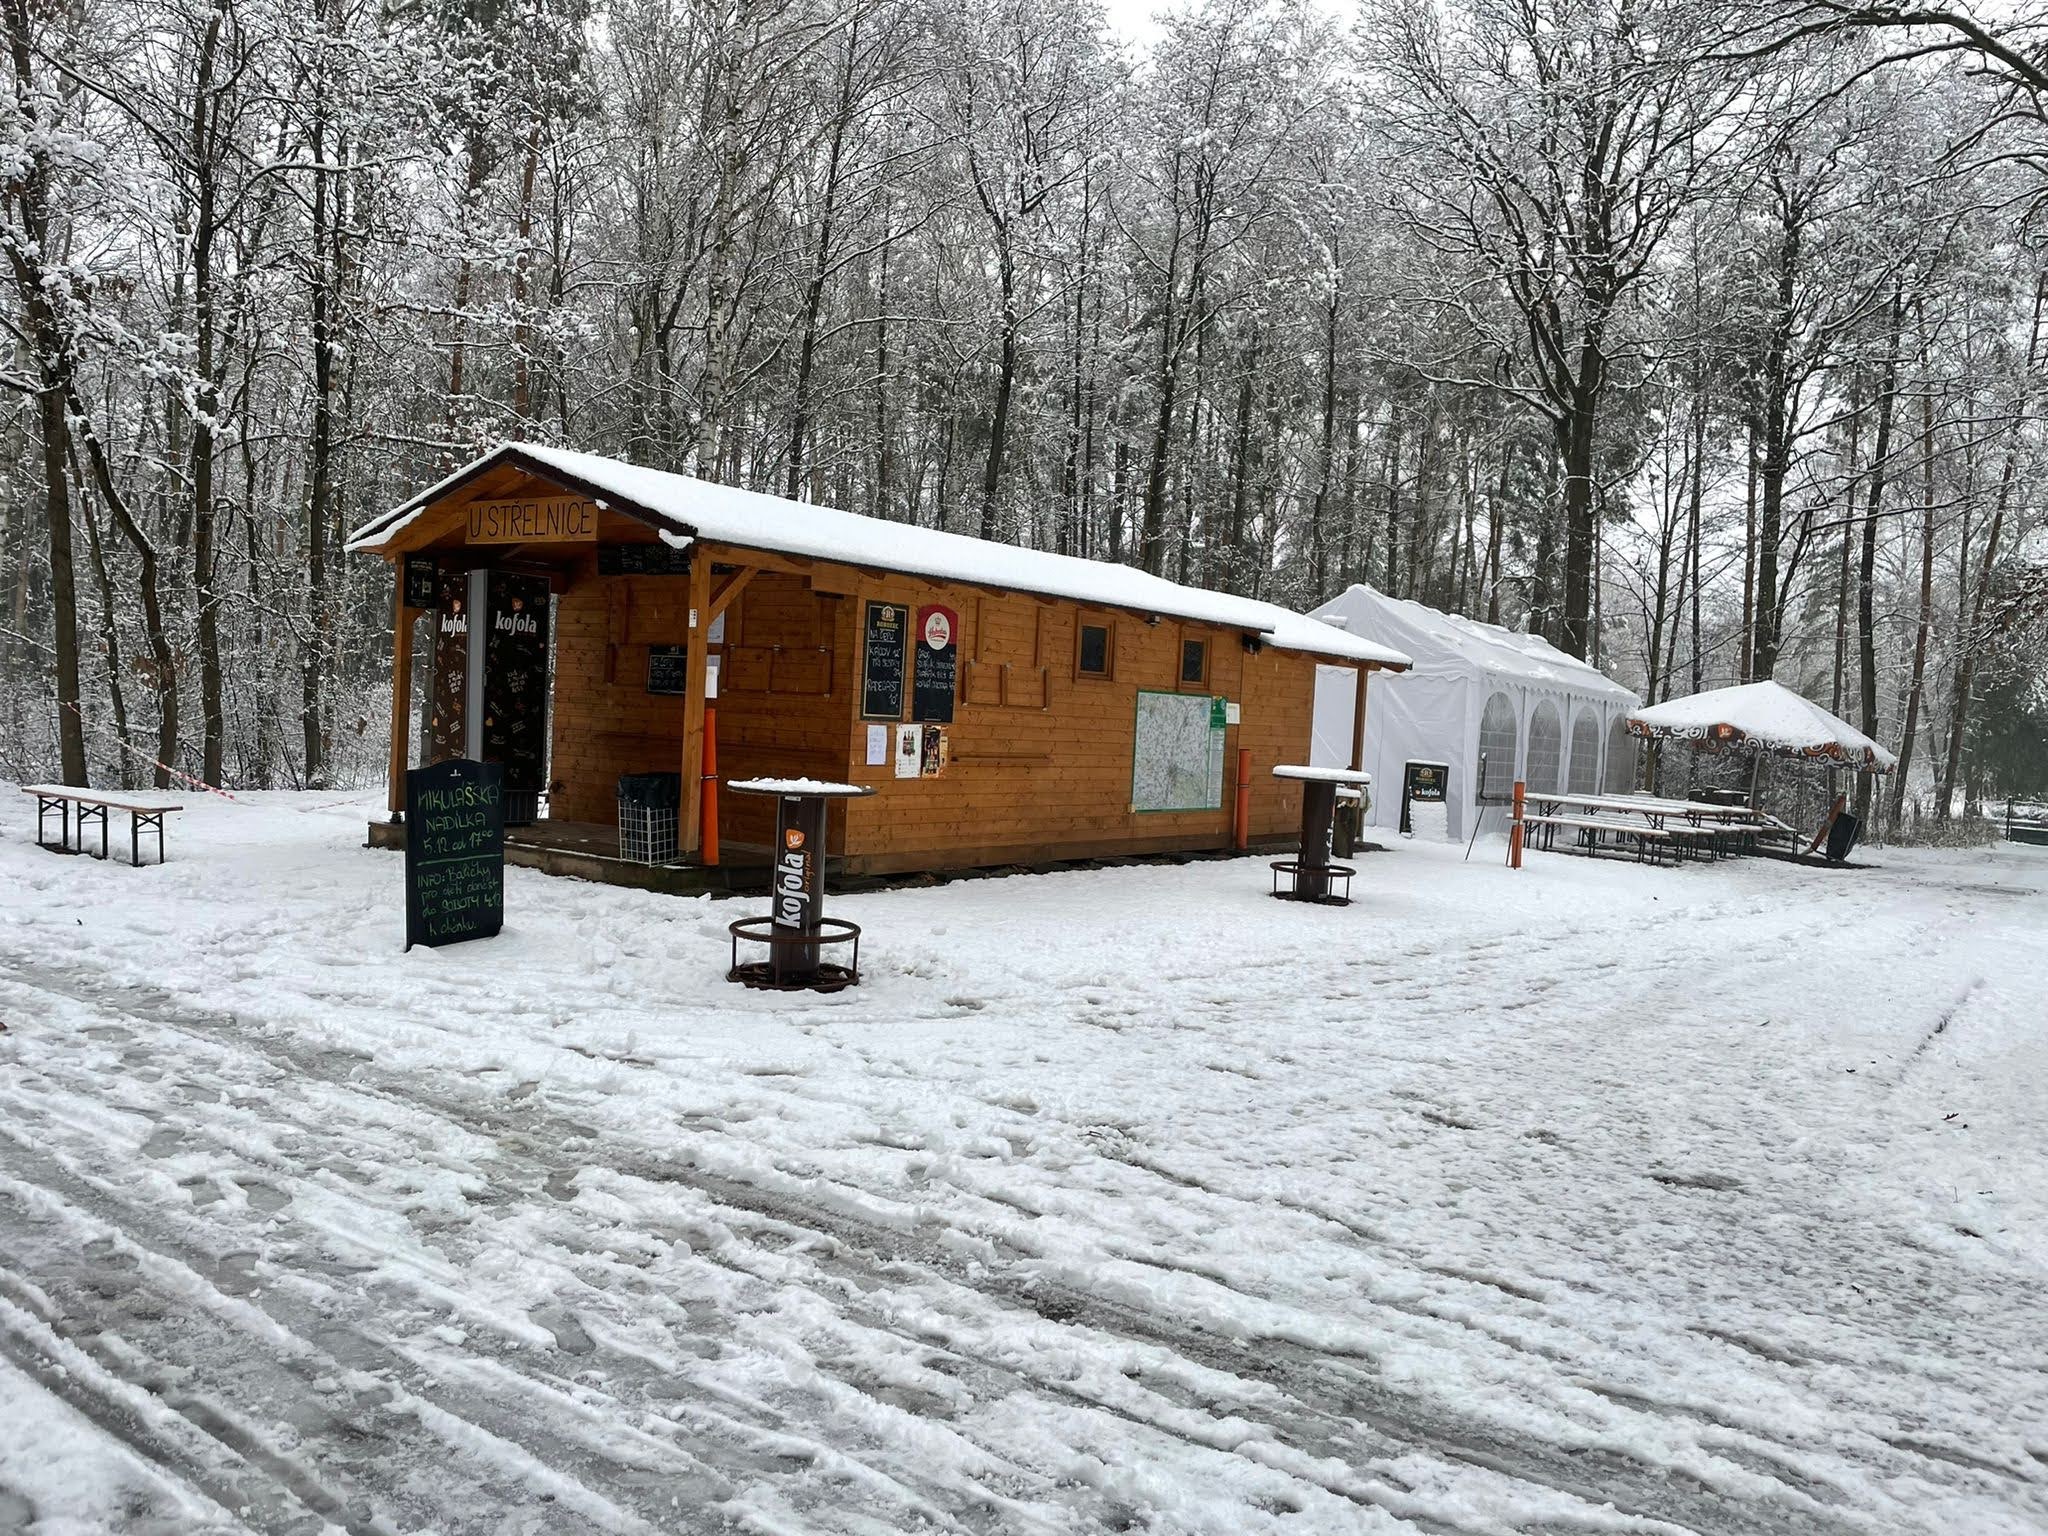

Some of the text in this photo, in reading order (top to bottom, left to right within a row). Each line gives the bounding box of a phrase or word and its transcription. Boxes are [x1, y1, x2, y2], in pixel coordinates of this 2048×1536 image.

[469, 500, 593, 538] U STŘELNICE
[495, 610, 537, 636] kofola
[1421, 787, 1440, 797] kofola
[775, 852, 810, 929] kofola
